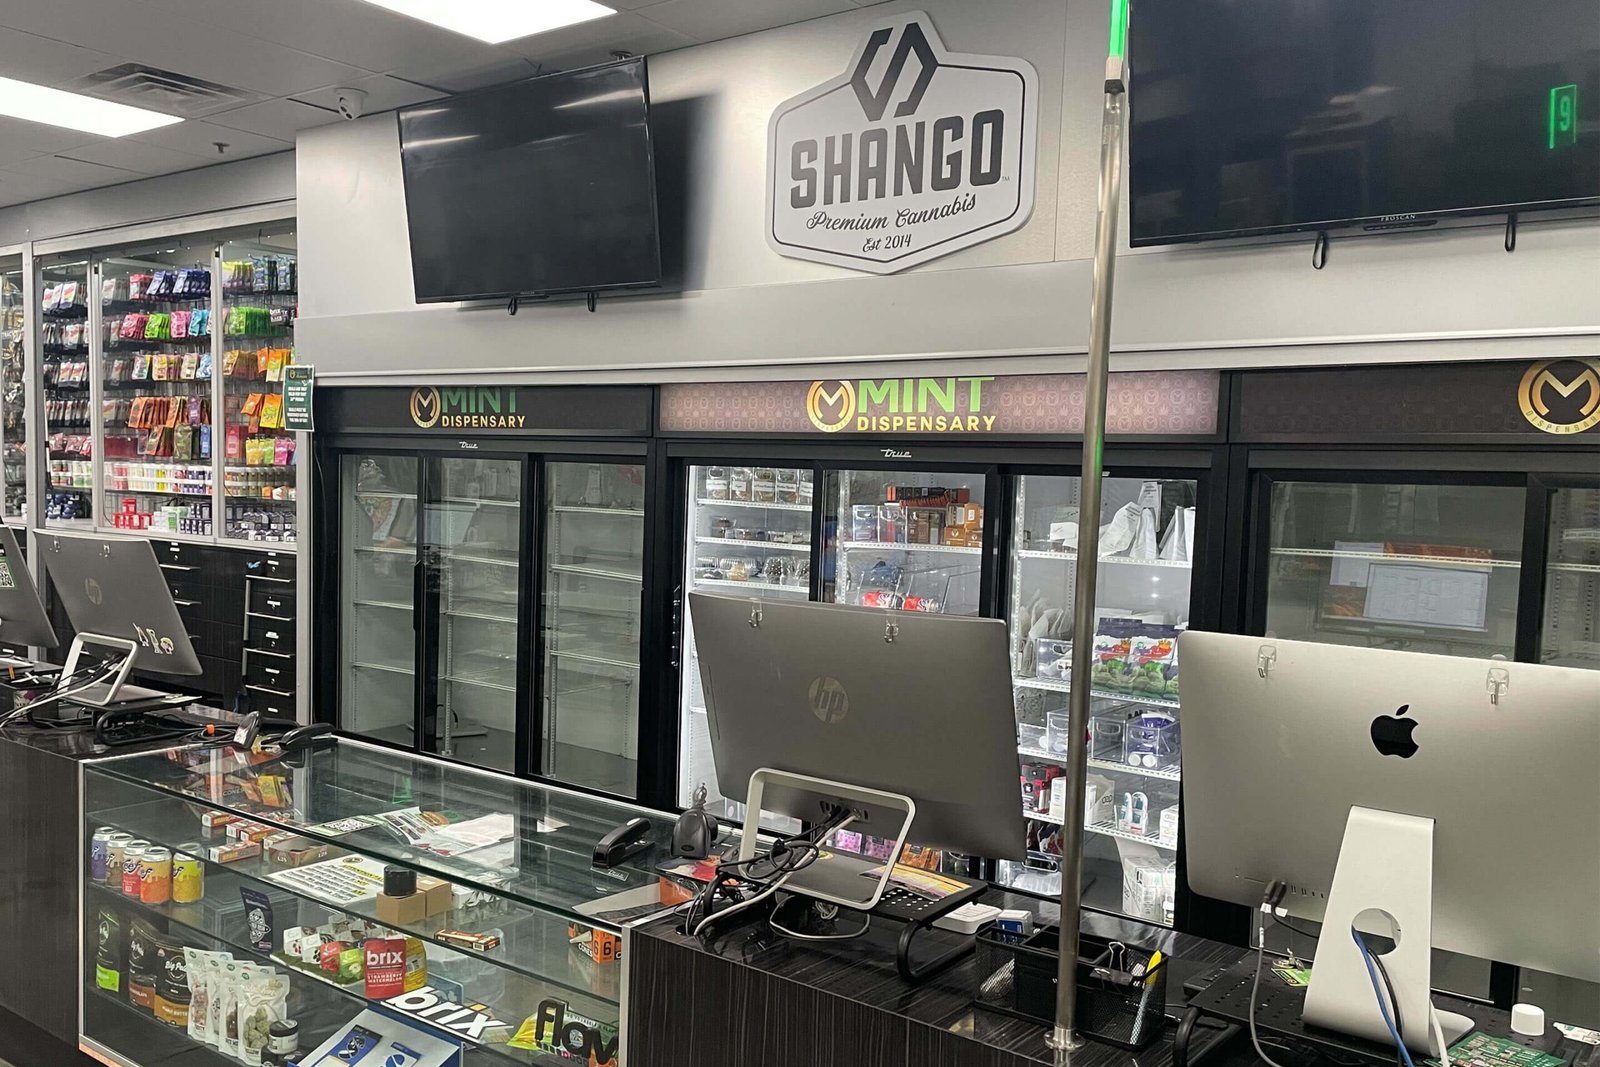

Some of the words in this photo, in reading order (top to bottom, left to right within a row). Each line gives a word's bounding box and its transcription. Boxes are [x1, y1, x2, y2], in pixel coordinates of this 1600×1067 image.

[790, 109, 1004, 209] SHANGO
[806, 211, 888, 231] Premium
[895, 193, 976, 228] Cannabis
[862, 237, 881, 252] Est
[885, 234, 912, 250] 2014
[442, 387, 517, 413] MINT
[858, 377, 995, 413] MINT
[441, 415, 526, 428] DISPENSARY
[857, 415, 997, 432] DISPENSARY
[880, 448, 912, 457] True
[603, 941, 611, 955] 6
[367, 950, 403, 966] brix
[386, 985, 508, 1039] brix
